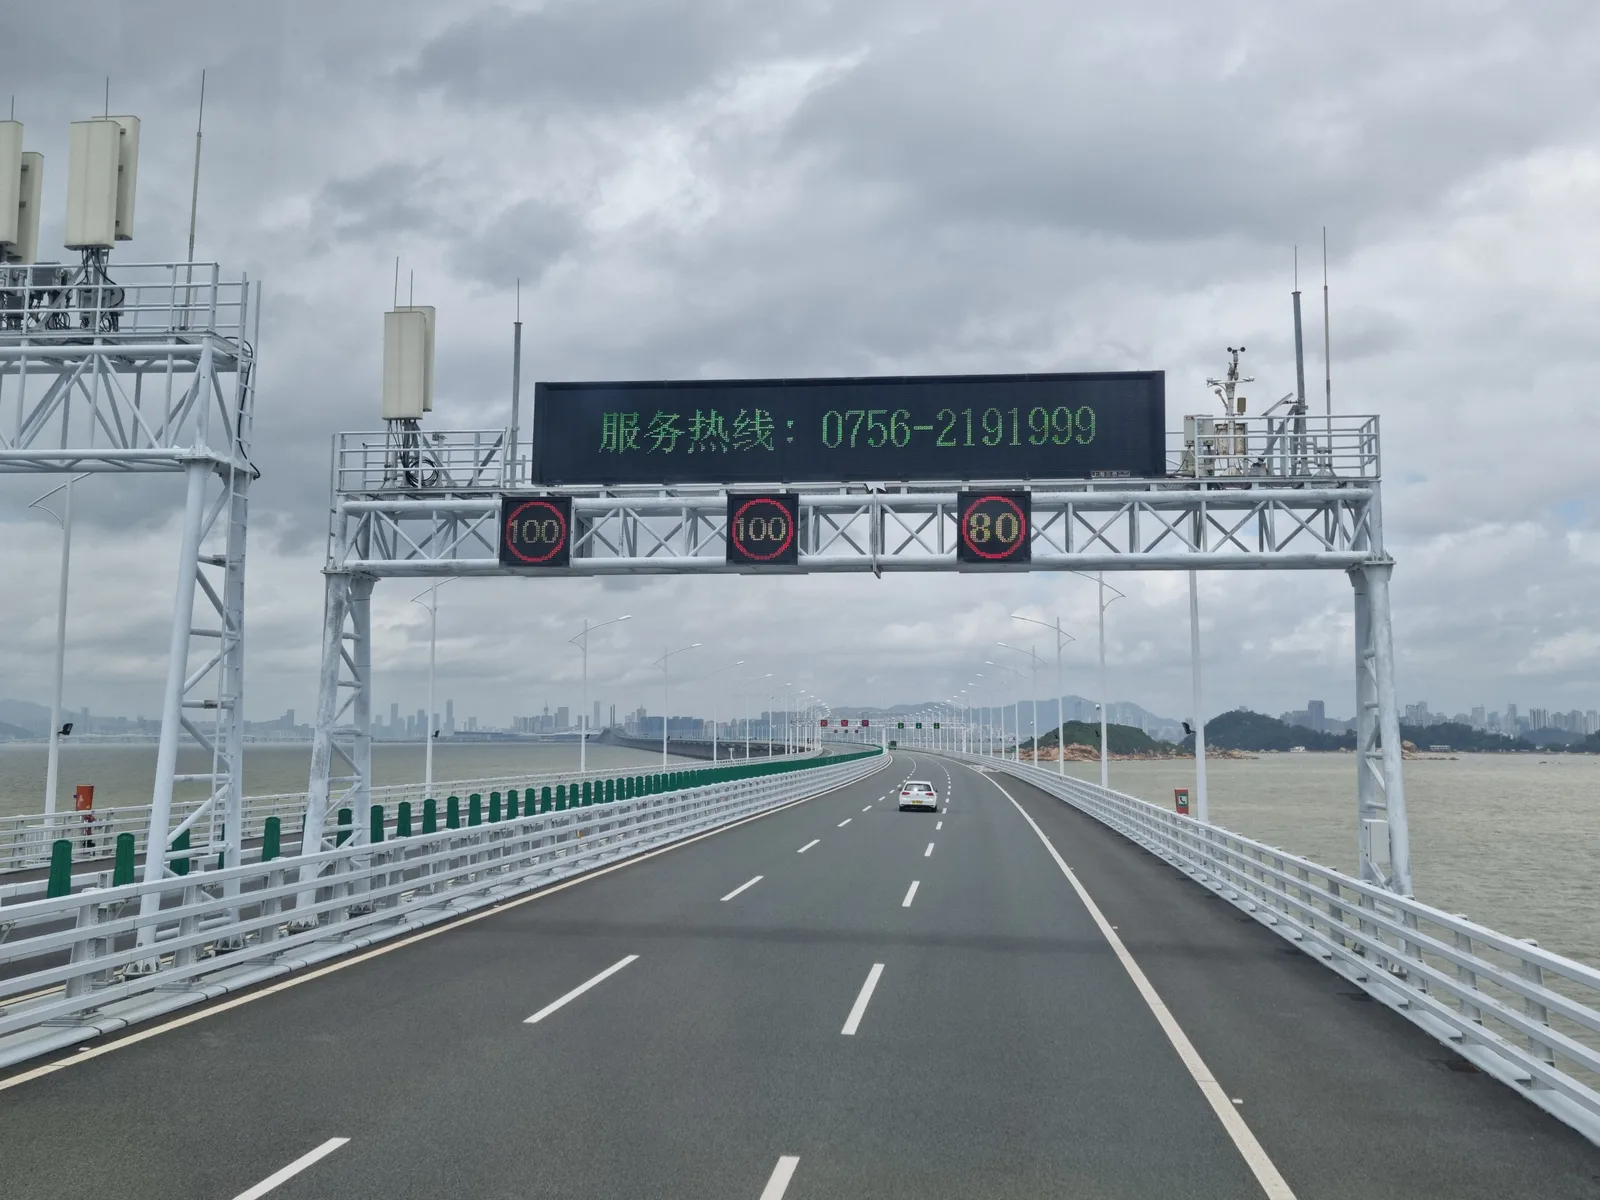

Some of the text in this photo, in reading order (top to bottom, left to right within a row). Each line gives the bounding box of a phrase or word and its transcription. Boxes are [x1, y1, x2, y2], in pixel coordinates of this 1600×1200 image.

[822, 406, 1096, 448] 0756-2191999
[510, 519, 559, 543] 100
[735, 517, 786, 541] 100
[970, 512, 1019, 543] 80
